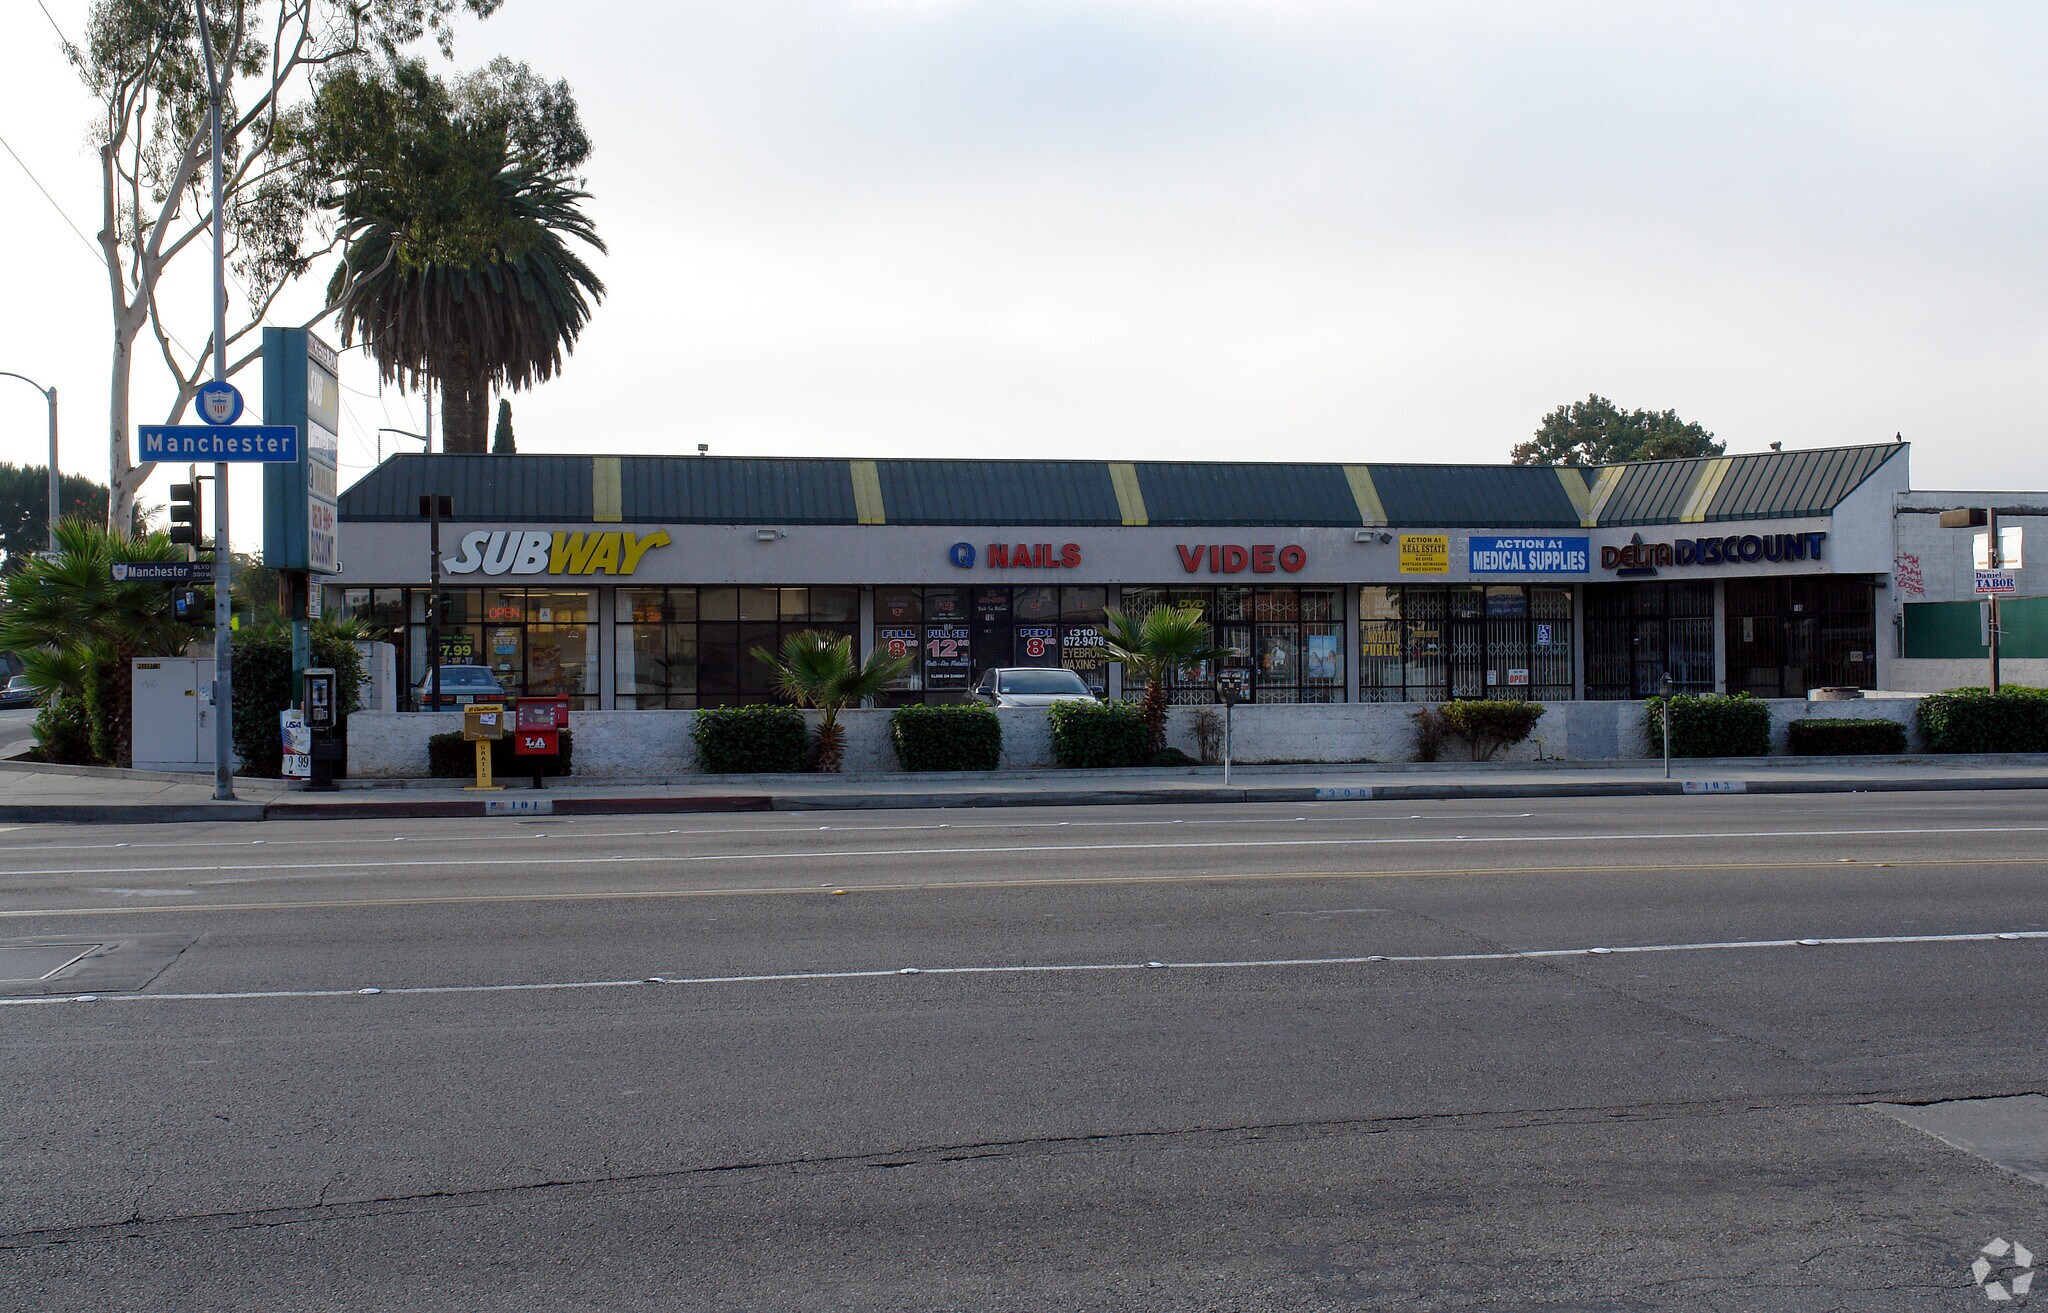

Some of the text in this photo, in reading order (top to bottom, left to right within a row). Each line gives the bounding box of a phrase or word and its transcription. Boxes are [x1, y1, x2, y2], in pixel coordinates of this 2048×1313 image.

[146, 433, 290, 453] Manchester
[1402, 544, 1446, 553] REAL ESTATE
[1495, 539, 1563, 549] ACTION A1
[441, 527, 672, 576] SUBWAY
[1601, 531, 1827, 569] DELTA DISCOUNT
[949, 542, 1082, 569] Q NAILS
[1176, 544, 1307, 574] VIDEO
[1473, 550, 1586, 571] MEDICAL SUPPLIES
[128, 565, 189, 578] Manchester
[1975, 571, 2002, 579] Daniel
[1975, 578, 2015, 588] TABOR
[1178, 599, 1206, 608] DVD
[488, 607, 520, 619] OPEN
[882, 629, 916, 639] FILL
[927, 629, 969, 638] FULL SET
[1020, 628, 1053, 638] PEDI
[1069, 628, 1098, 637] (310)
[1367, 630, 1396, 643] NOTARY
[926, 639, 958, 657] 12
[1363, 643, 1399, 657] PUBLIC
[1061, 659, 1096, 670] WAXING
[1509, 674, 1528, 683] OPEN
[525, 737, 546, 747] LA
[1704, 781, 1730, 790] 103
[1328, 788, 1366, 799] 300
[512, 801, 538, 810] 101
